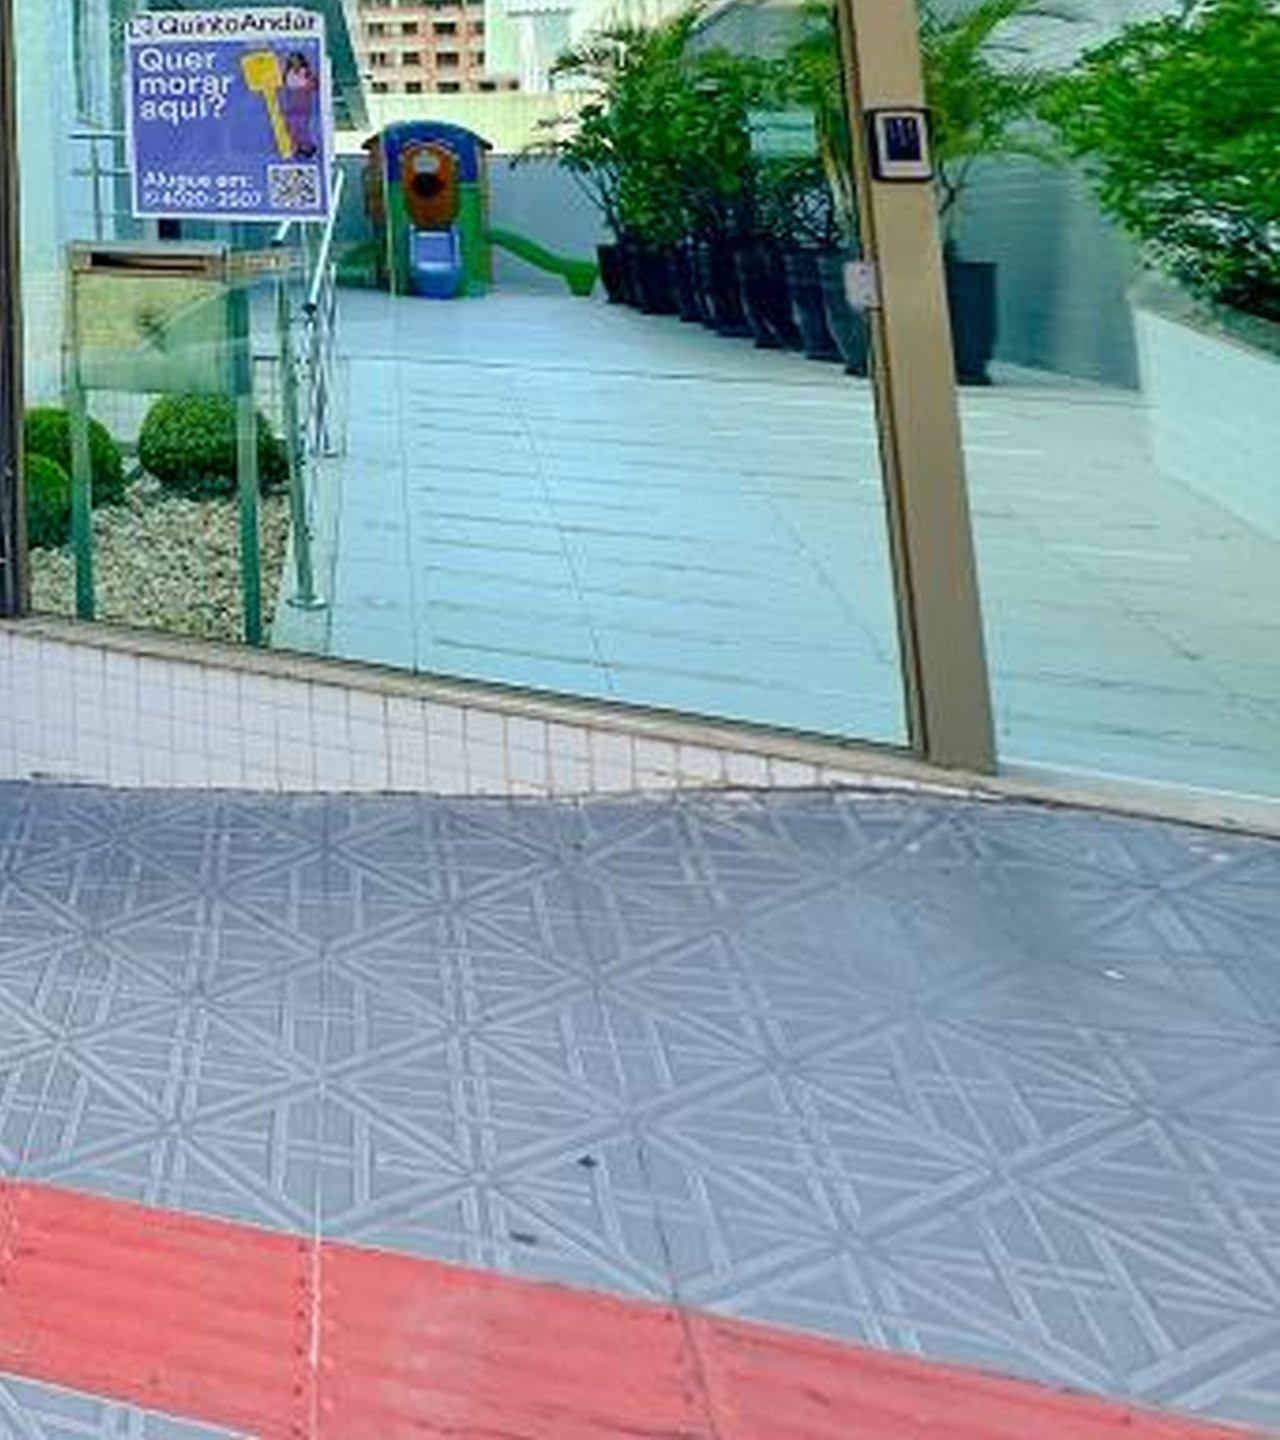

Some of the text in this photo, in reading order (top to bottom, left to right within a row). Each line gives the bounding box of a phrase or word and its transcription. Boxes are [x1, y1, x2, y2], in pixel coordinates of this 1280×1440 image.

[138, 47, 217, 73] Quer
[139, 74, 234, 95] morar
[139, 93, 227, 126] aqui?
